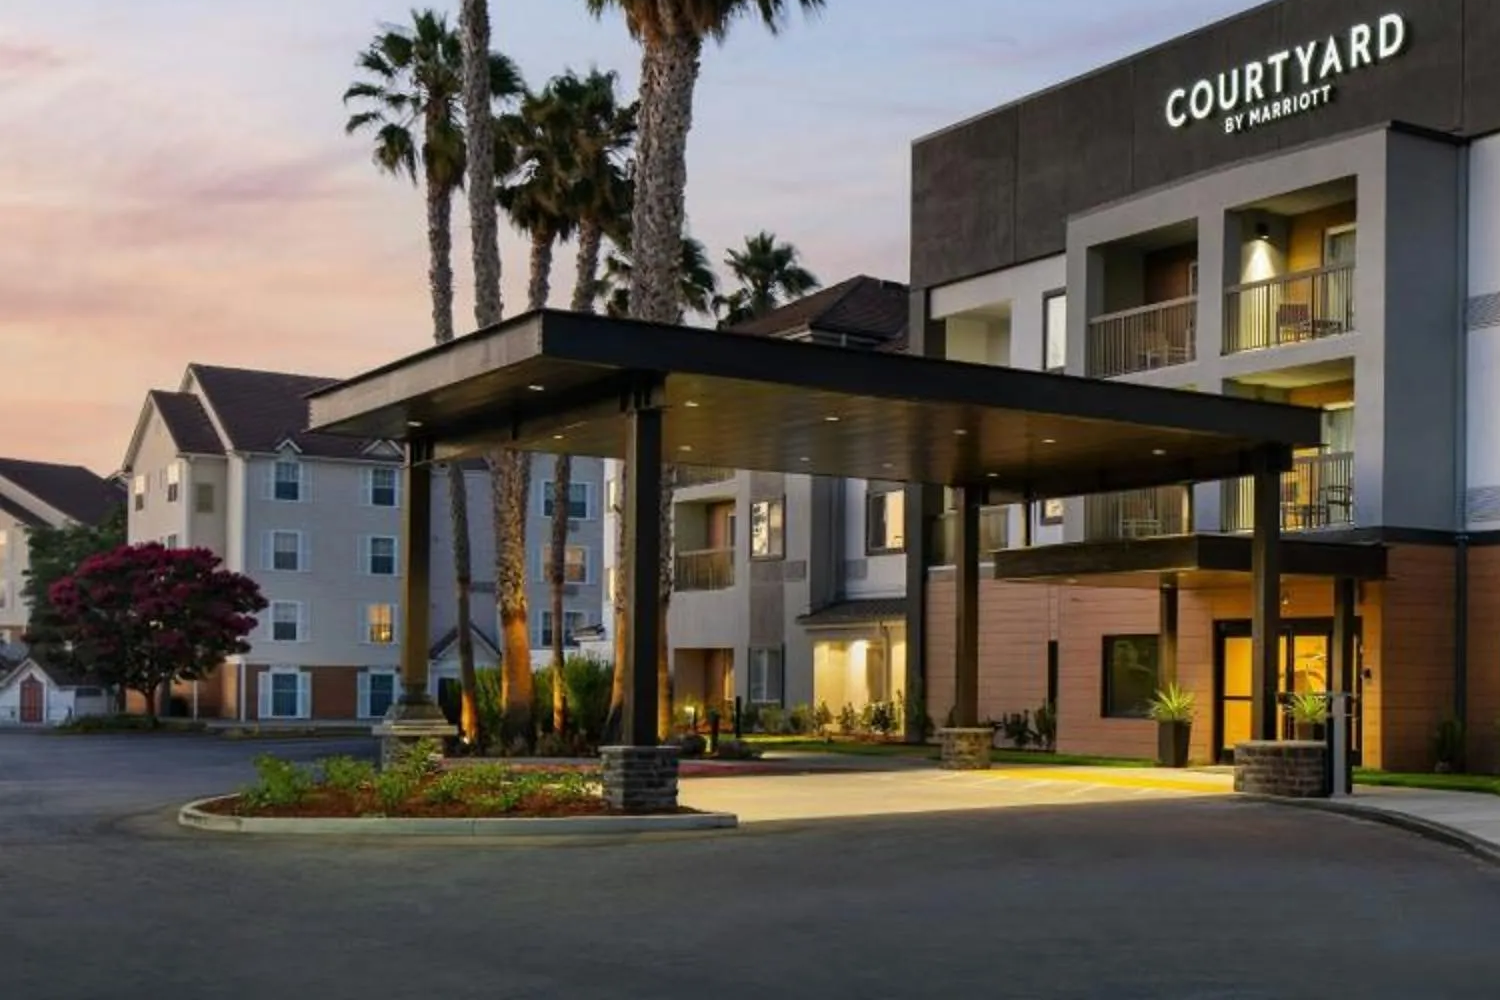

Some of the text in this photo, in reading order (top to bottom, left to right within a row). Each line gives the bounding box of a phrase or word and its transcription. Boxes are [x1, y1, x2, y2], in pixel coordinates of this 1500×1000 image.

[1165, 13, 1404, 127] COURTYARD
[1224, 85, 1331, 133] BY MARRIOTT
